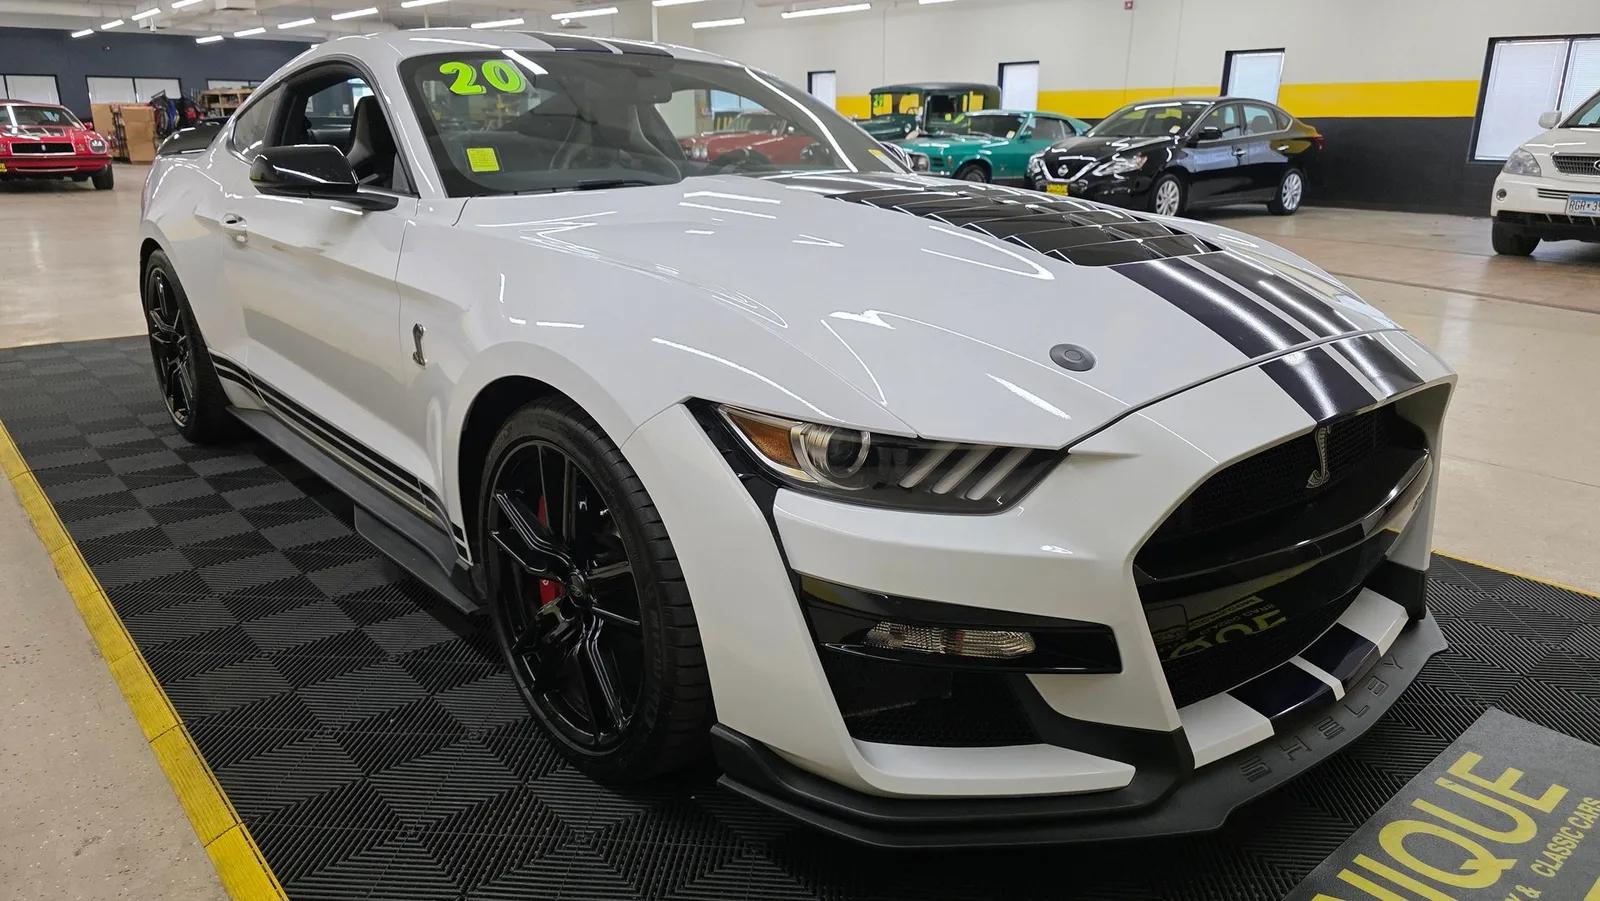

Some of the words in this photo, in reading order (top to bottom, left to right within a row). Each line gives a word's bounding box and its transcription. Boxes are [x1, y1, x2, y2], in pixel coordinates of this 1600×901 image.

[440, 60, 526, 95] 20
[1239, 654, 1404, 783] SHELBY
[1530, 826, 1585, 878] CLASSIC
